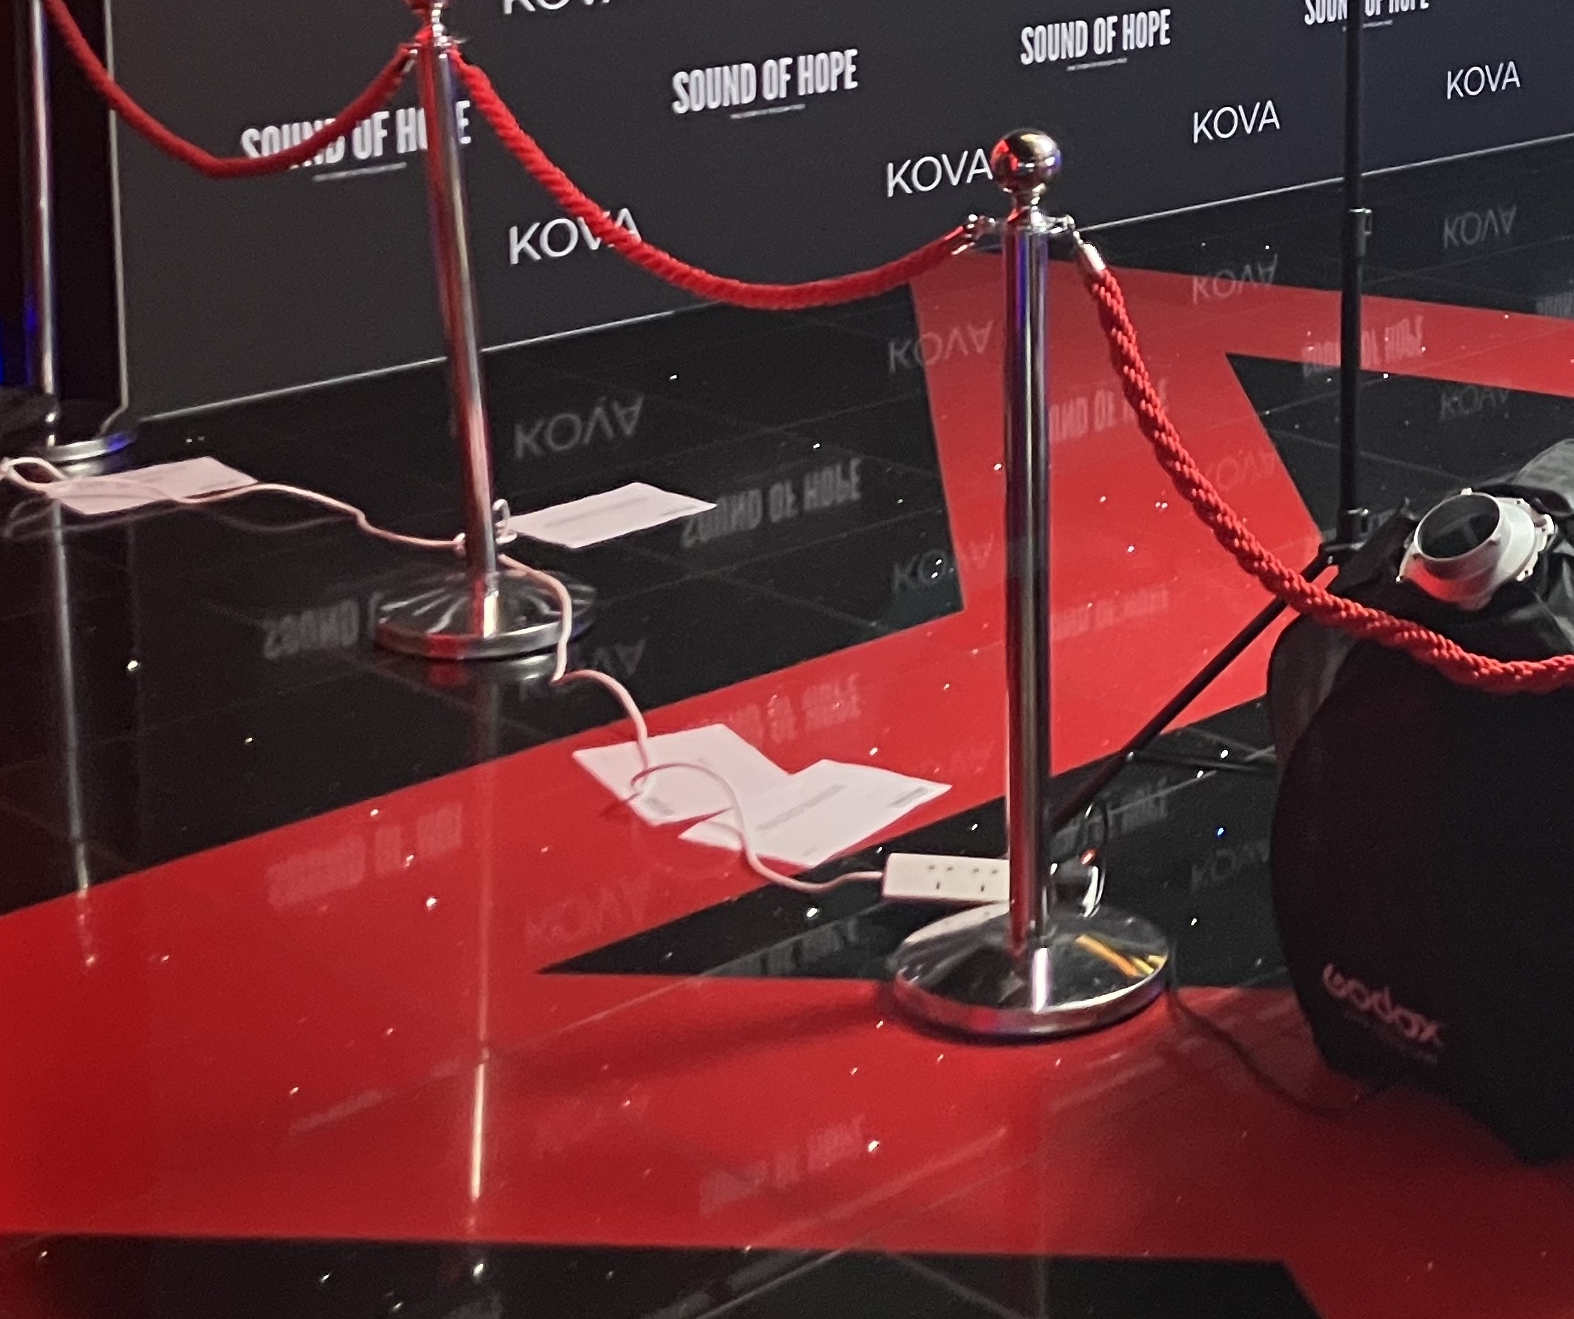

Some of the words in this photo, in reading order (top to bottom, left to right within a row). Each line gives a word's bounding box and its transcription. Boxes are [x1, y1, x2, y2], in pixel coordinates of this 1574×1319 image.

[1020, 20, 1089, 65] SOUND
[1093, 15, 1118, 55] OF
[1123, 8, 1171, 51] HOPE
[672, 62, 757, 114] SOUND
[762, 57, 793, 101] OF
[798, 48, 858, 96] HOPE
[1447, 60, 1521, 100] KOVA
[352, 111, 390, 161] OF
[1193, 100, 1280, 144] KOVA
[887, 148, 992, 198] KOVA
